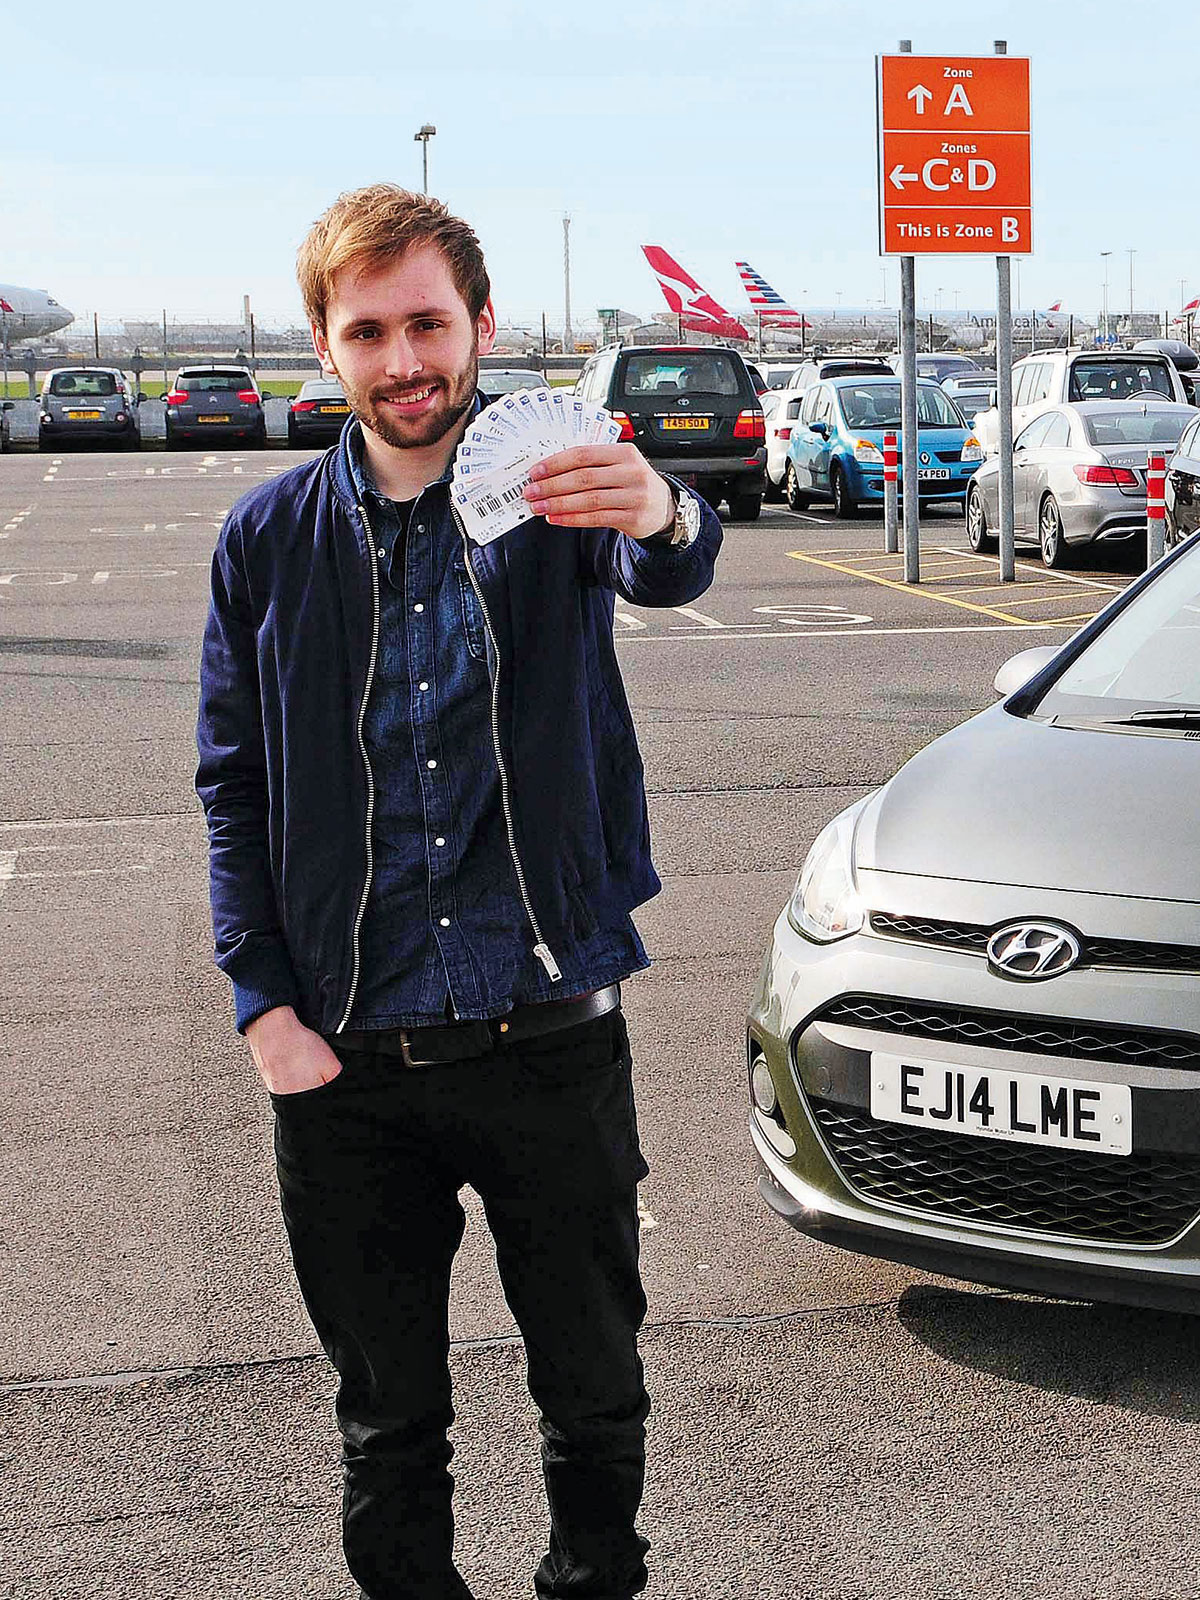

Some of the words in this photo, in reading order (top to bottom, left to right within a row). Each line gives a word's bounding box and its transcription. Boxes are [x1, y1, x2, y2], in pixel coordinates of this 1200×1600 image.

[943, 66, 973, 78] Zone
[943, 83, 974, 116] A
[941, 142, 977, 154] Zones
[896, 223, 932, 238] This
[936, 223, 950, 238] is
[954, 224, 994, 238] Zone
[1001, 216, 1020, 243] B
[971, 315, 1040, 328] Amcan
[900, 1064, 995, 1127] EJ14
[1009, 1080, 1101, 1142] LME
